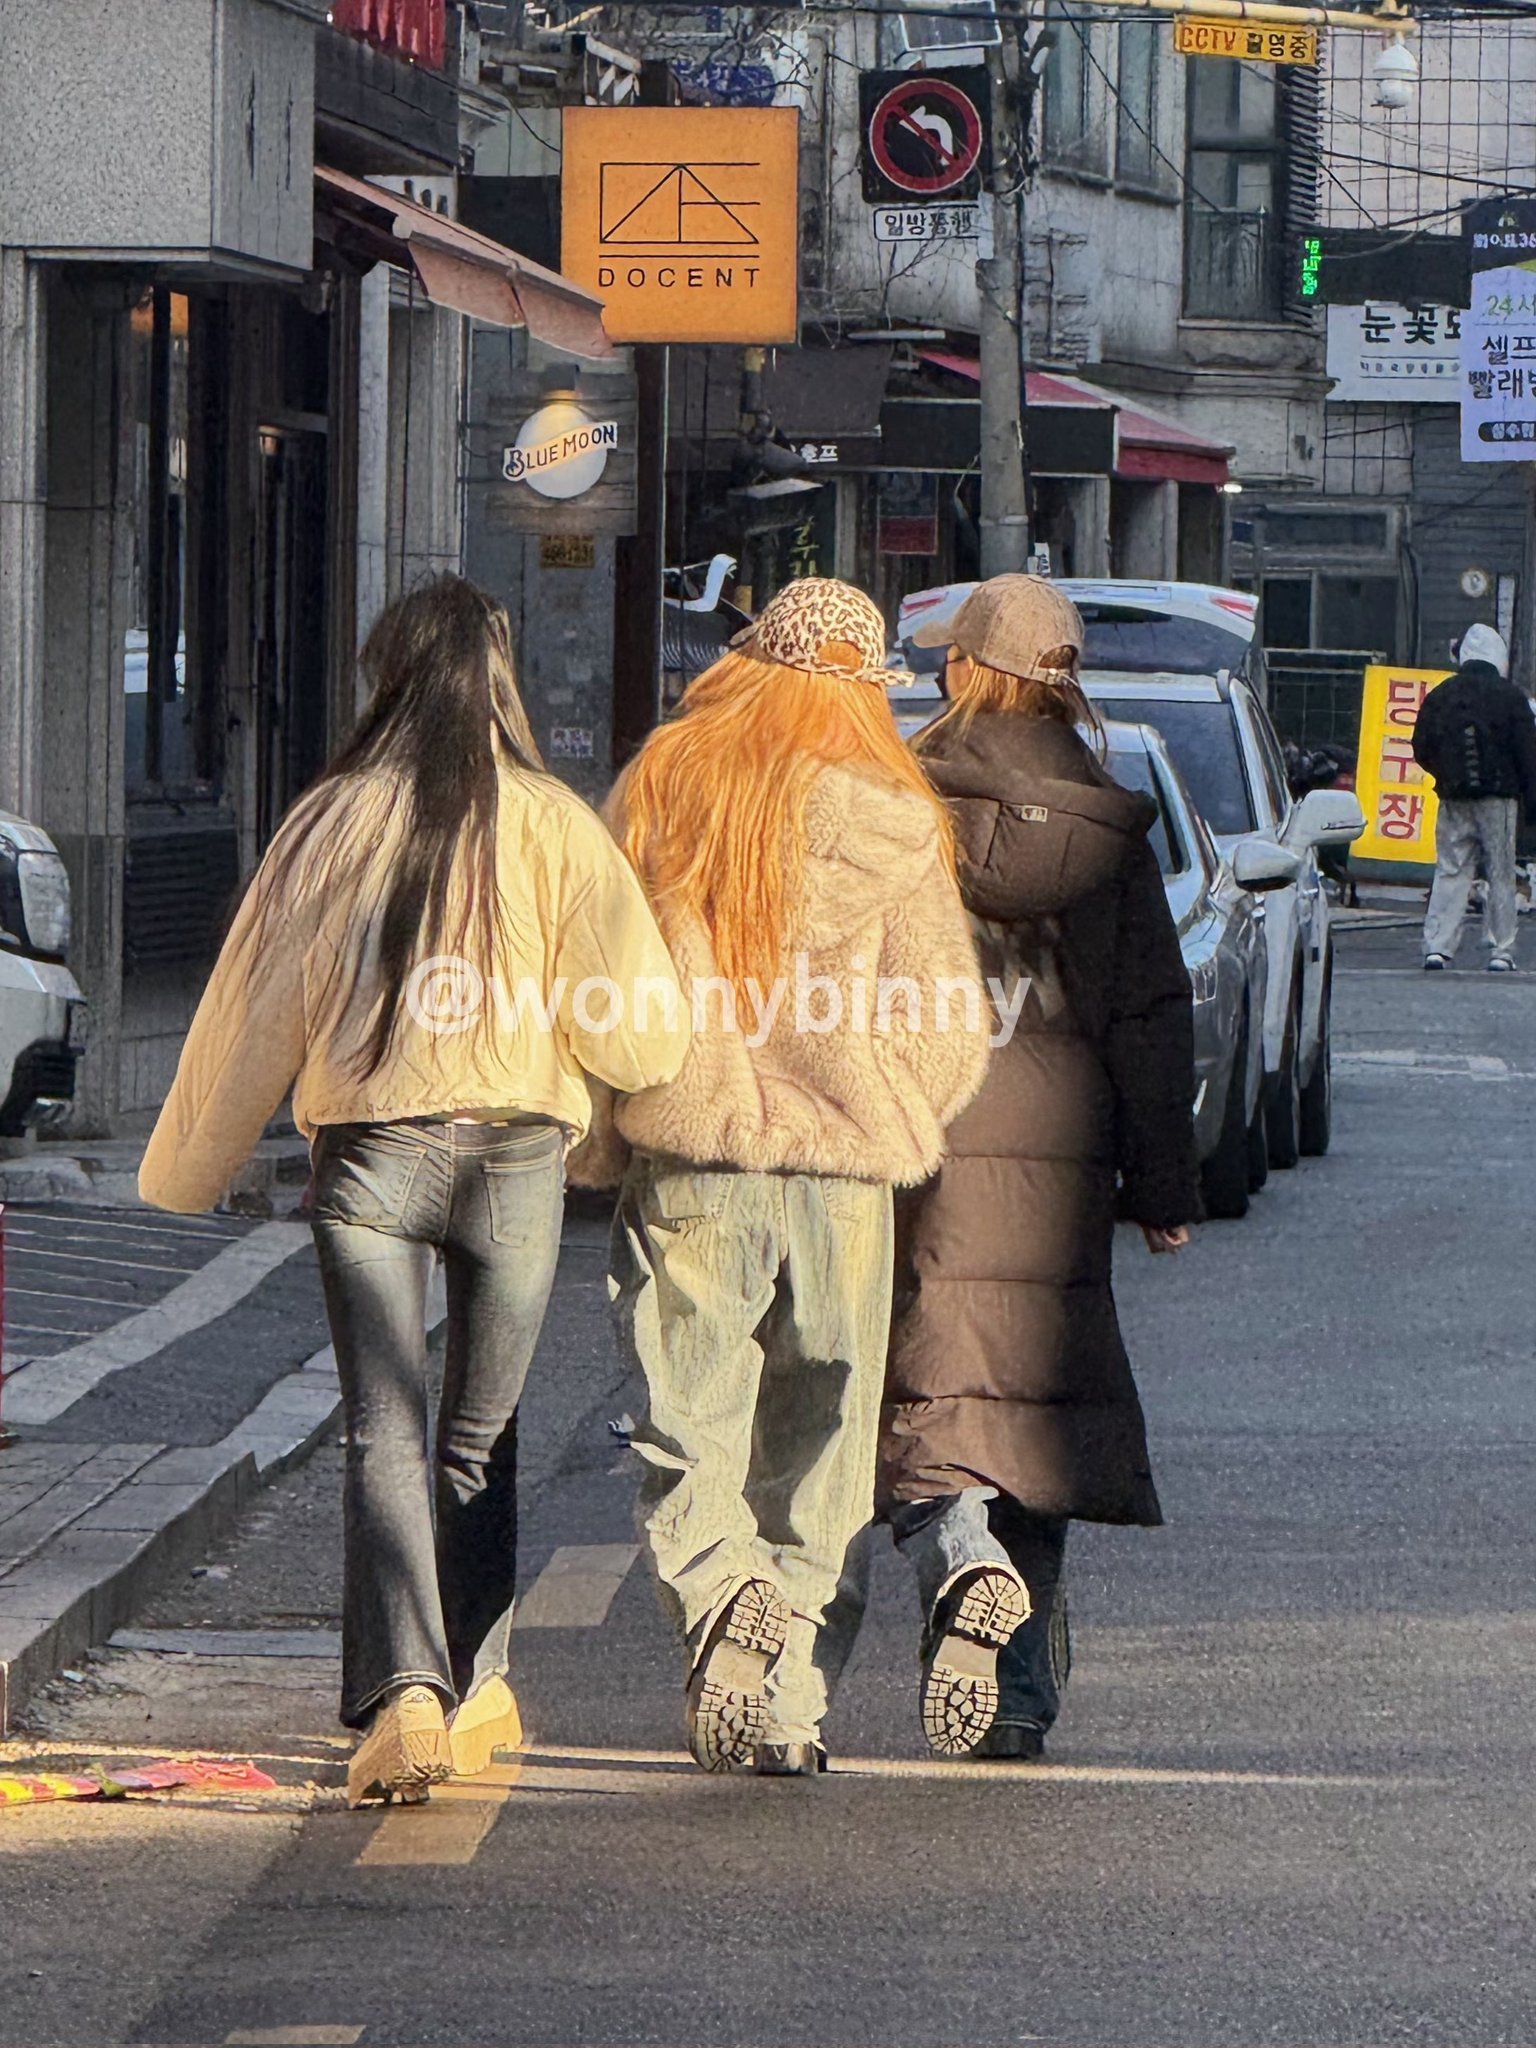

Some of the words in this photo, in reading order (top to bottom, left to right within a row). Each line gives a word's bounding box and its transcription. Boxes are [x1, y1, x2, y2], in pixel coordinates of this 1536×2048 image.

[1181, 26, 1236, 51] CCTV
[598, 267, 760, 288] DOCENT
[505, 443, 559, 478] BLUE
[562, 424, 616, 458] MOON
